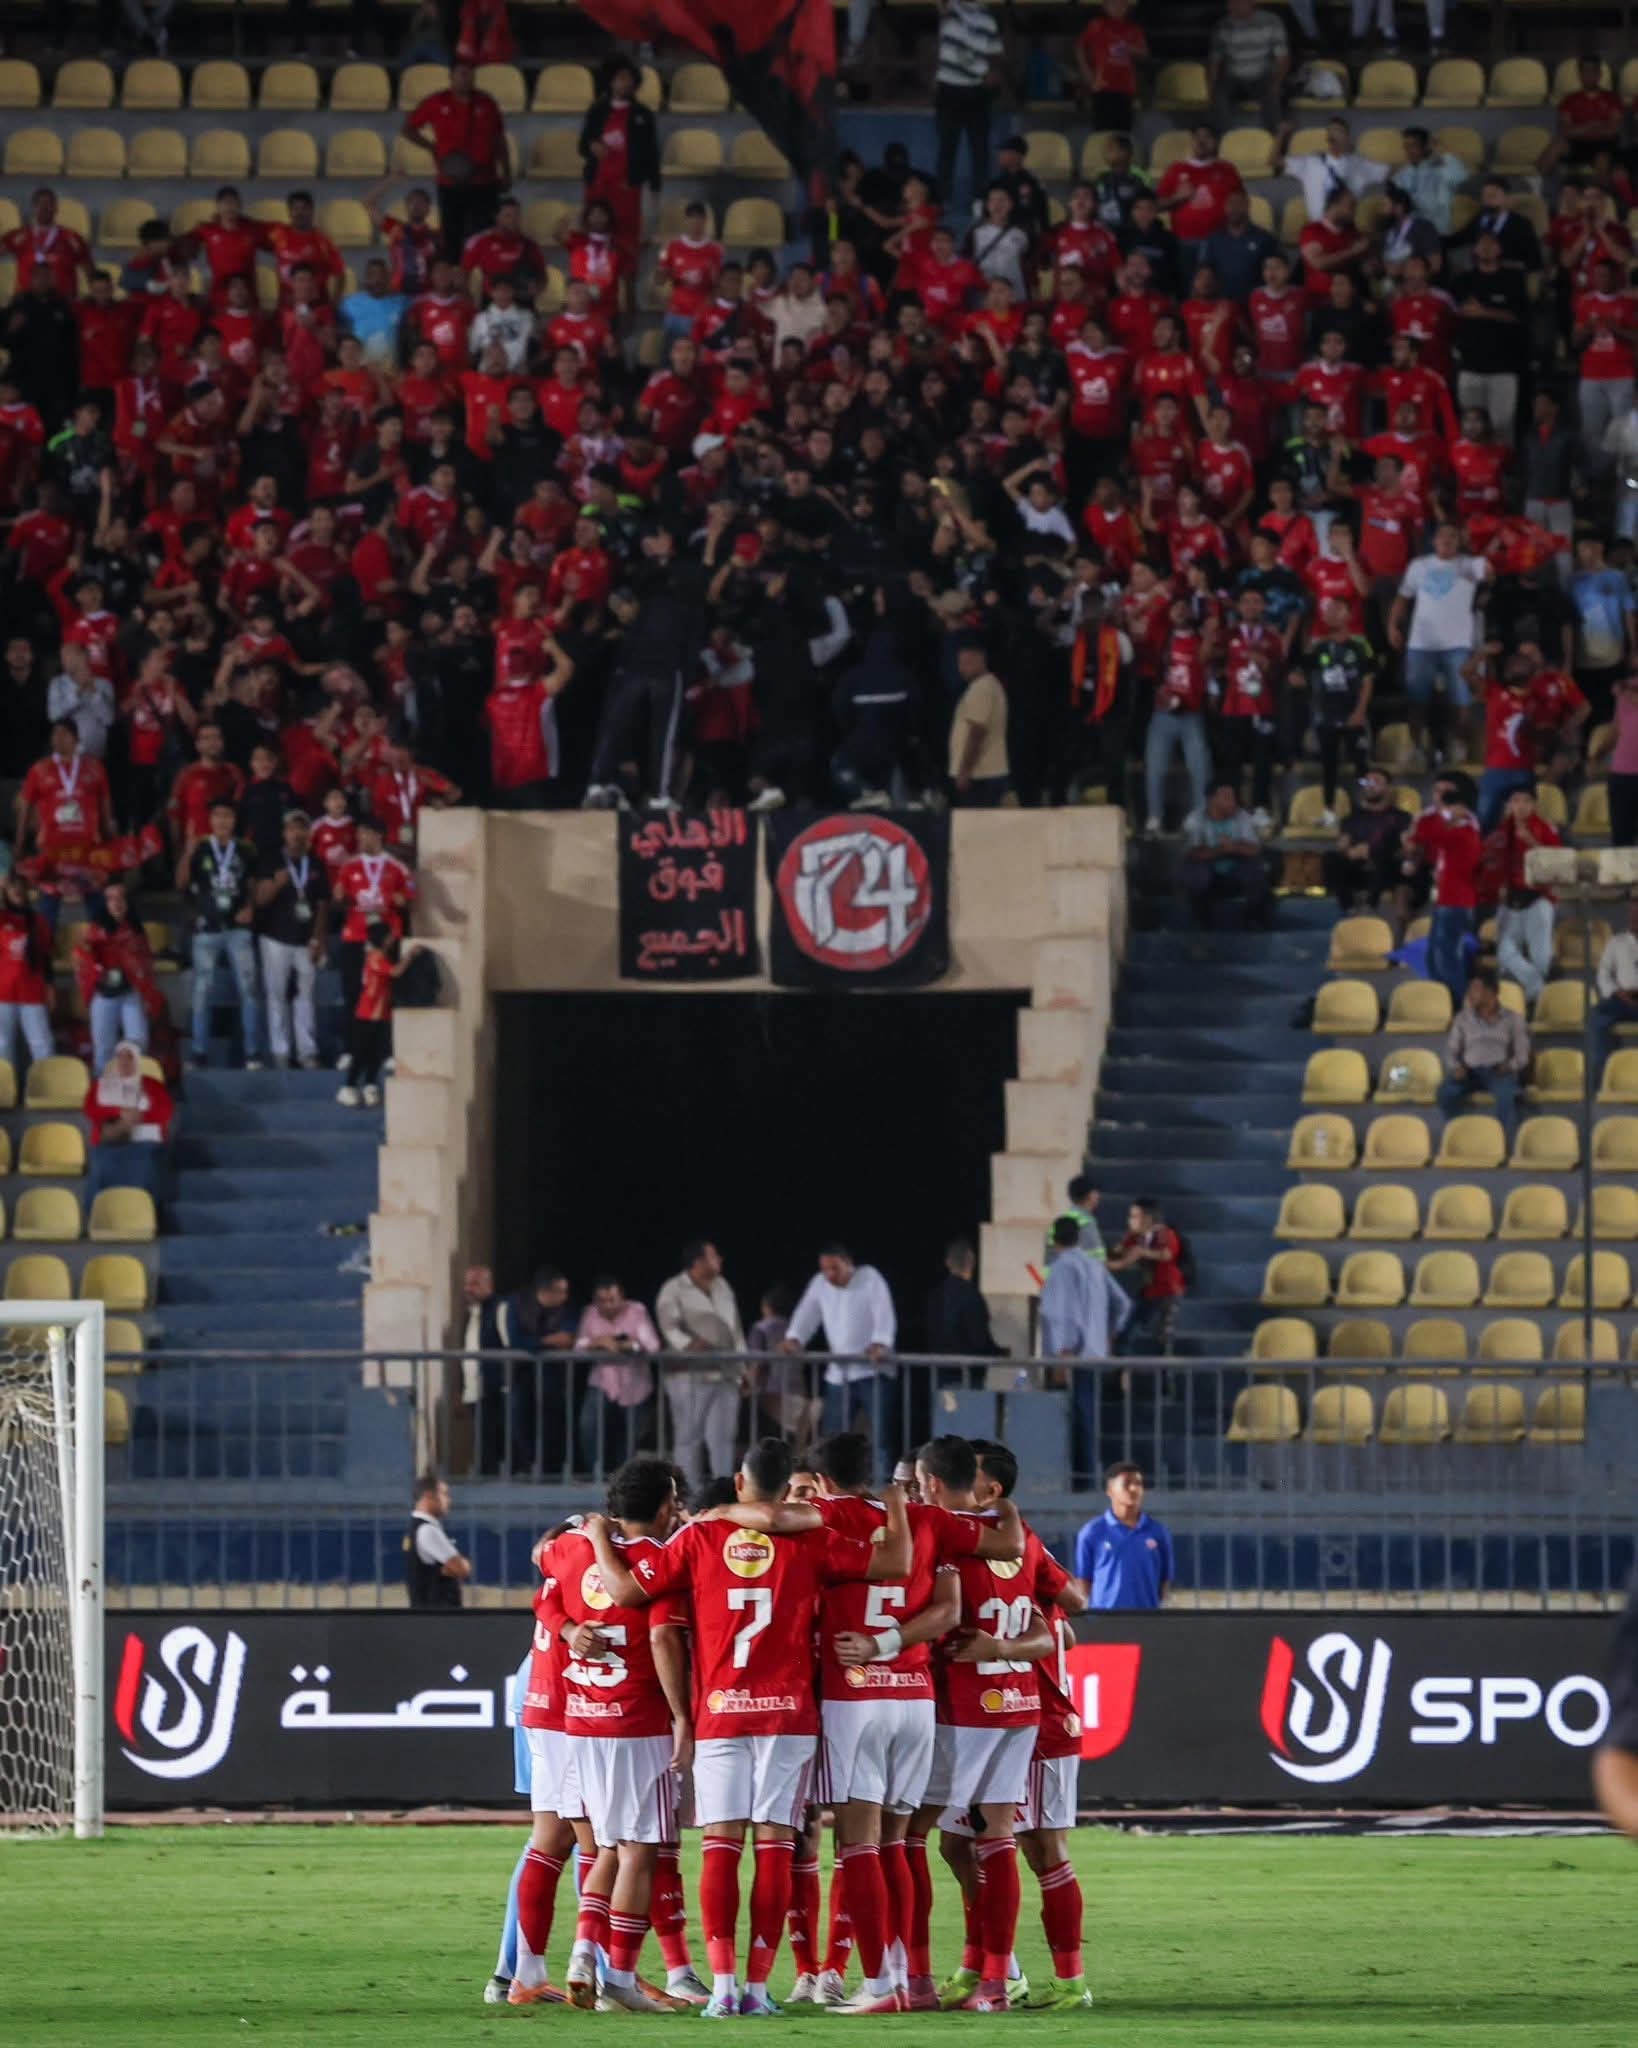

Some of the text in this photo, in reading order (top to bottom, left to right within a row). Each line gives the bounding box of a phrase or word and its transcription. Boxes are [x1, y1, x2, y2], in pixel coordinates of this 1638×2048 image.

[648, 851, 725, 901] فوق
[727, 1587, 772, 1669] 7
[864, 1585, 905, 1662] 5
[1410, 1675, 1611, 1746] SPO
